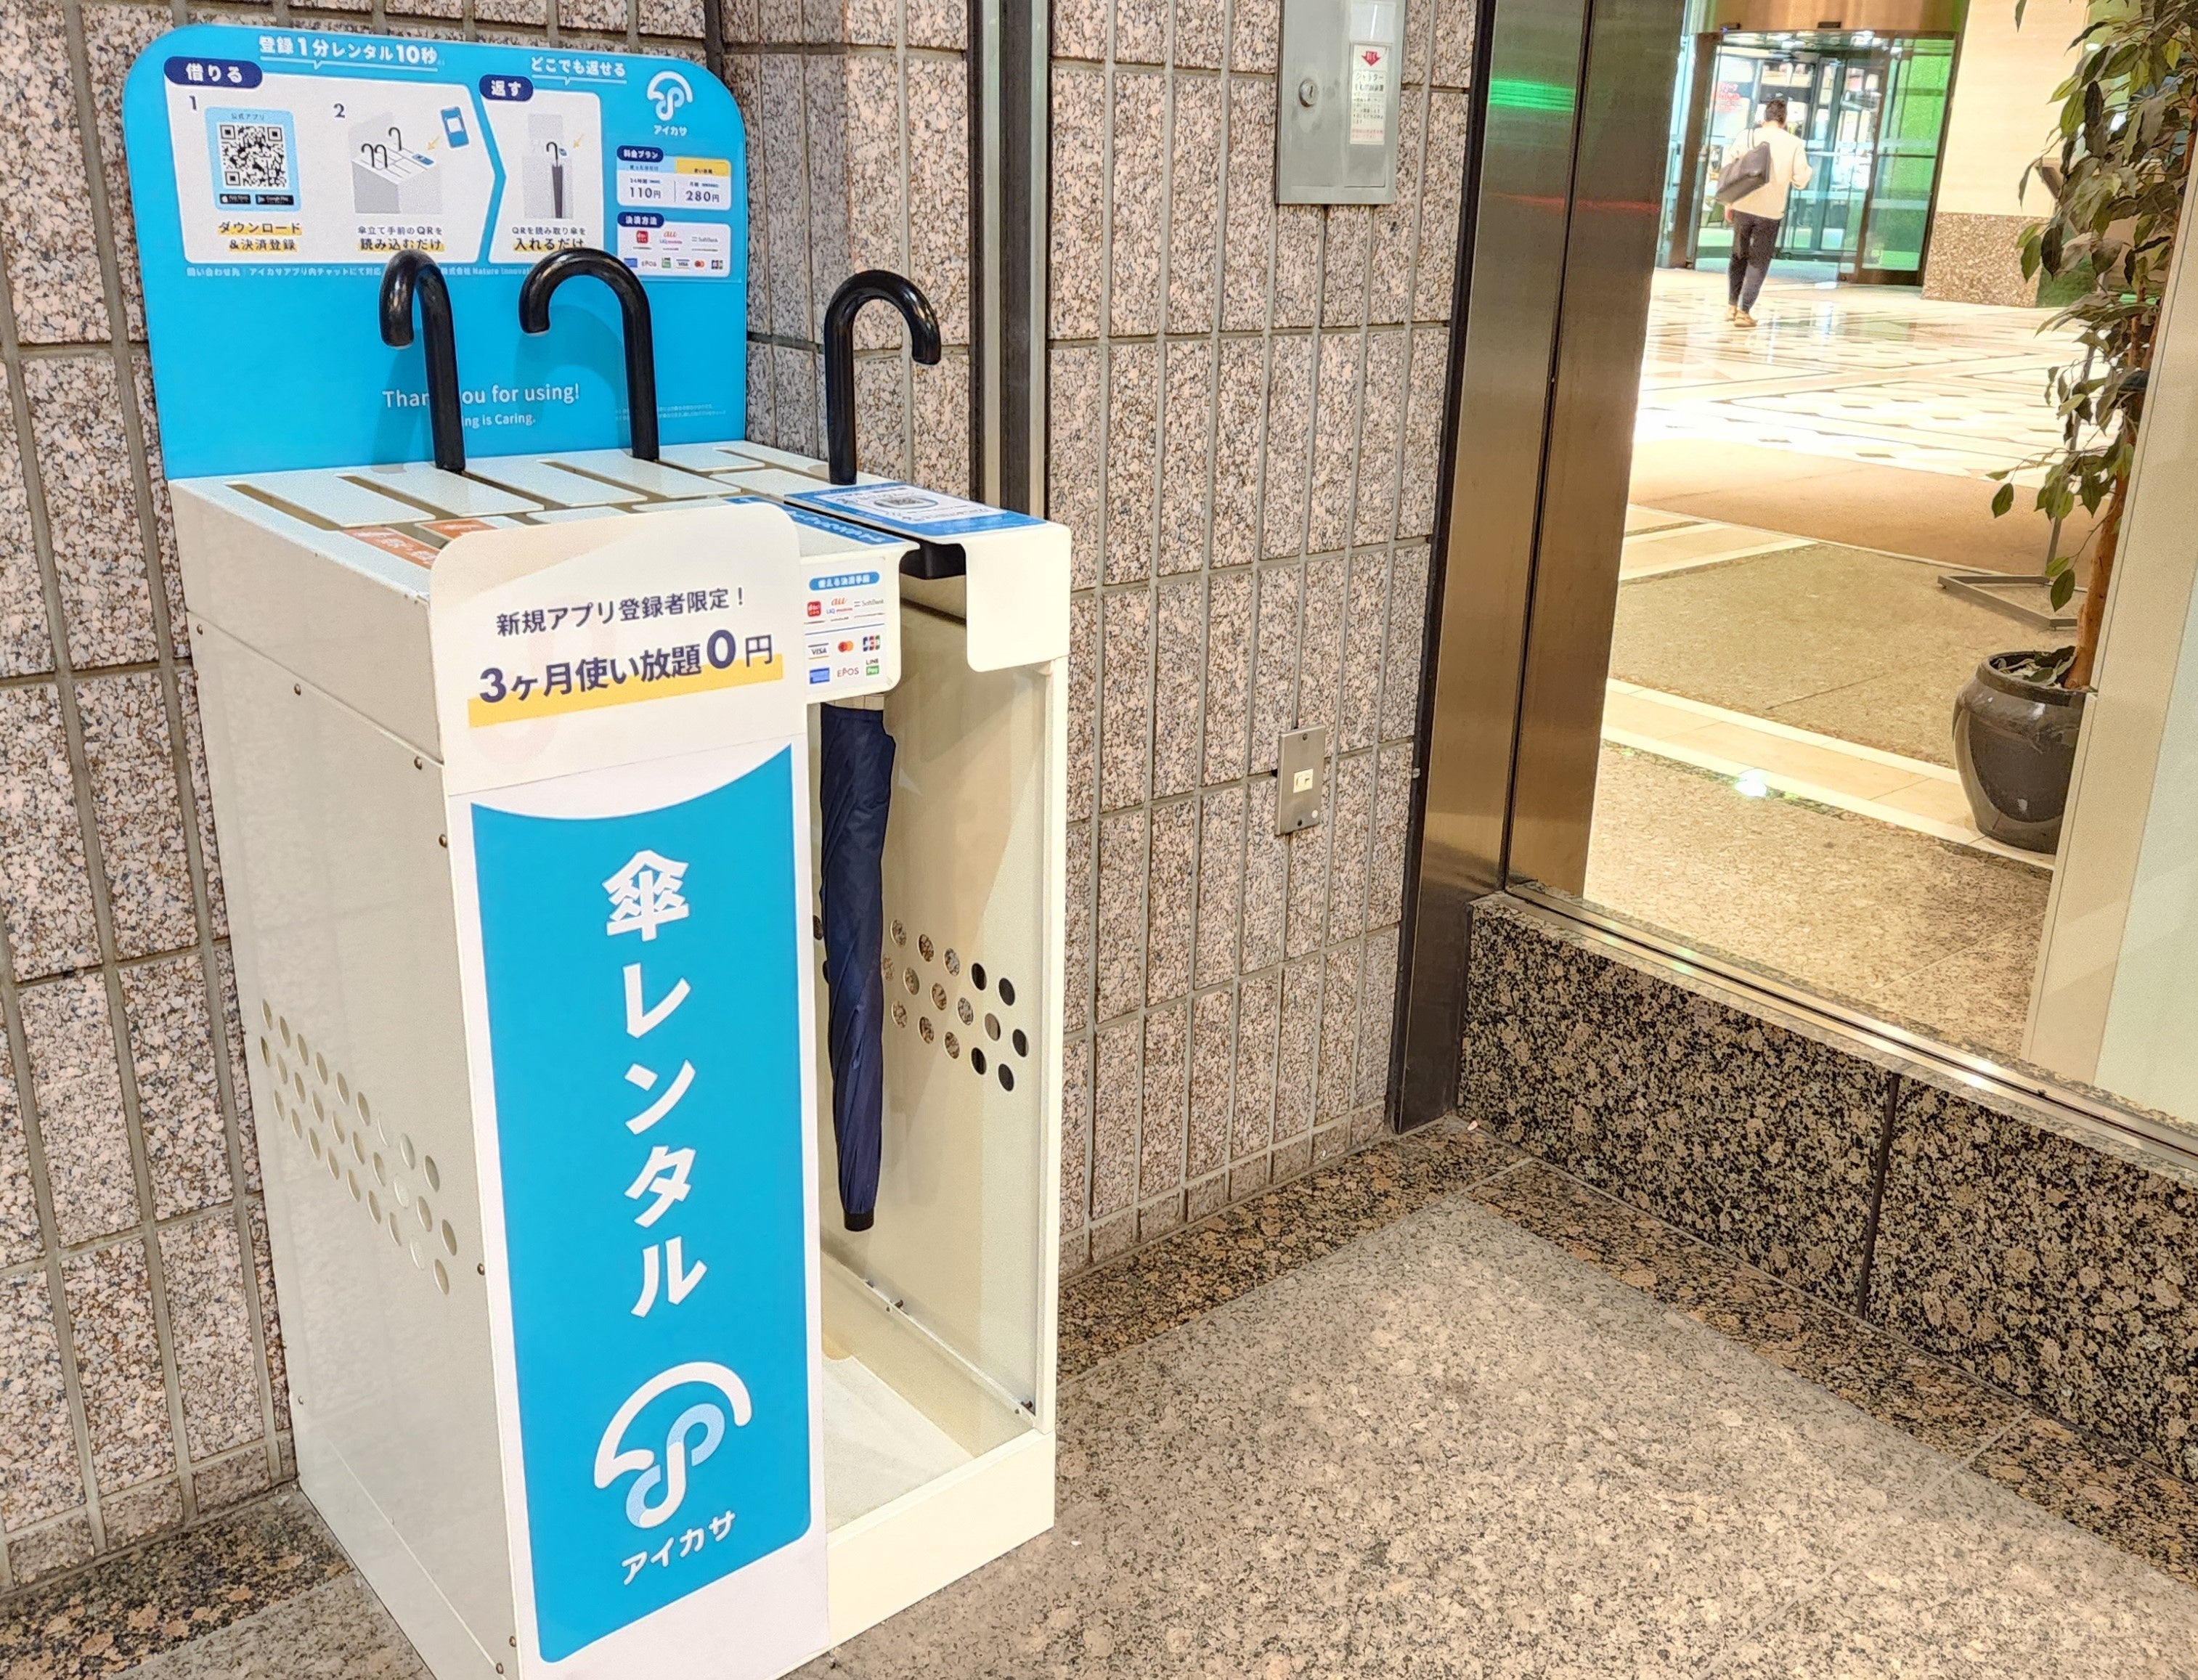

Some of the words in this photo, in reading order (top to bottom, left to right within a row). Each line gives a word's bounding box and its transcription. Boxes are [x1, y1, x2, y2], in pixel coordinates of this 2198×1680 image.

[259, 36, 438, 65] 登録1分レンタル10秒
[185, 62, 243, 83] 借りる
[532, 56, 627, 77] どこでも返せる
[491, 79, 521, 97] 返す
[189, 95, 198, 111] 1
[333, 103, 346, 118] 2
[653, 124, 688, 136] アイカサ
[623, 149, 659, 159] 料金プラン
[630, 187, 662, 199] 110円
[685, 190, 720, 203] 280円
[219, 221, 301, 235] ダウンロード
[357, 225, 443, 235] 傘立て手前のQRを
[511, 227, 586, 235] QRを読み取り傘を
[229, 239, 296, 251] &決済登録
[360, 238, 442, 250] 読み込むだけ
[514, 237, 584, 250] 入れるだけ
[461, 390, 486, 405] ou
[492, 384, 519, 403] for
[525, 383, 579, 404] using!
[482, 414, 492, 425] is
[494, 412, 537, 426] Caring.
[831, 597, 847, 606] au
[495, 587, 744, 637] 新規アプリ登録者限定！
[837, 666, 860, 677] EPOS
[601, 848, 707, 1319] 傘レンタル
[621, 1509, 736, 1586] アイカサ
